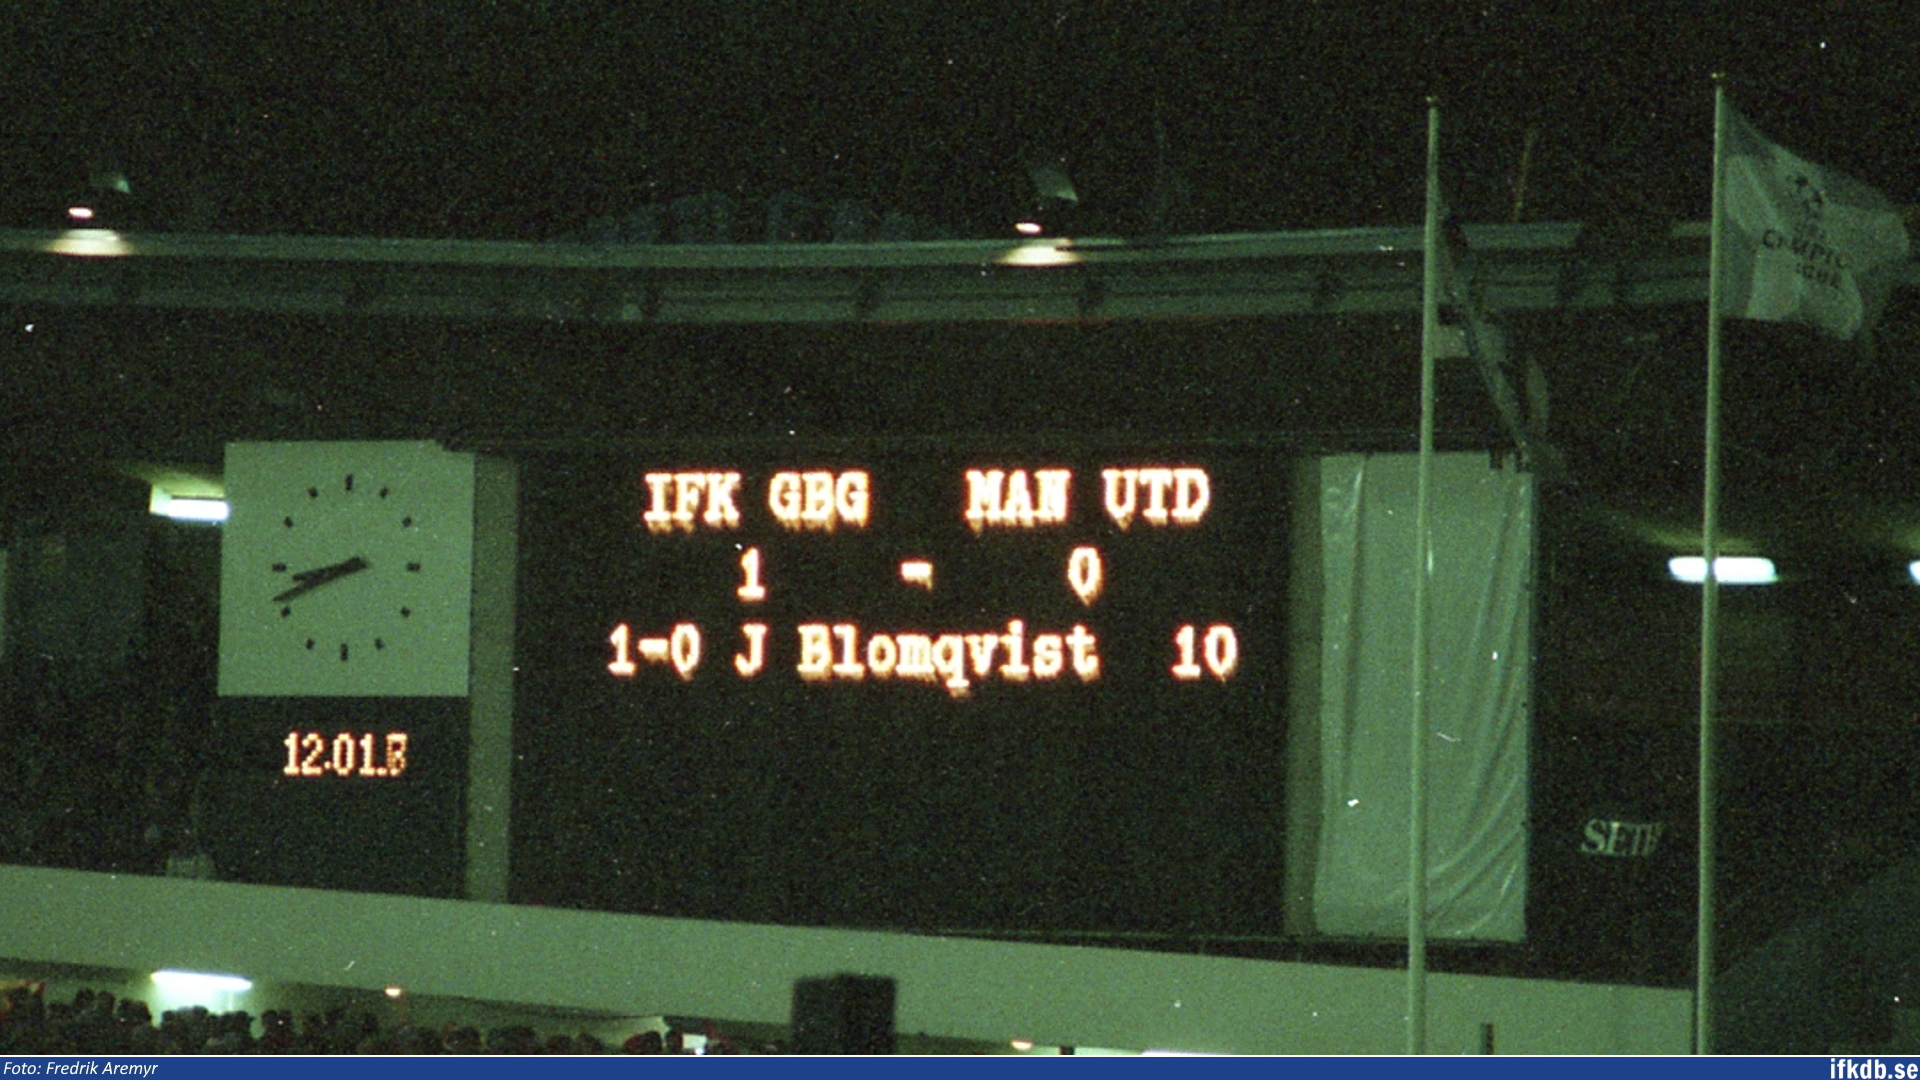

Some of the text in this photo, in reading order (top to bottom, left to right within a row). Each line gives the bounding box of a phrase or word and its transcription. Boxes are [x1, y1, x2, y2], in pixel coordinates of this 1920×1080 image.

[643, 465, 1211, 530] IFK GBG MAN UTD
[736, 547, 767, 600] 1
[1067, 546, 1104, 603] 0
[608, 619, 1239, 696] 1-0 J Blomqvist 10
